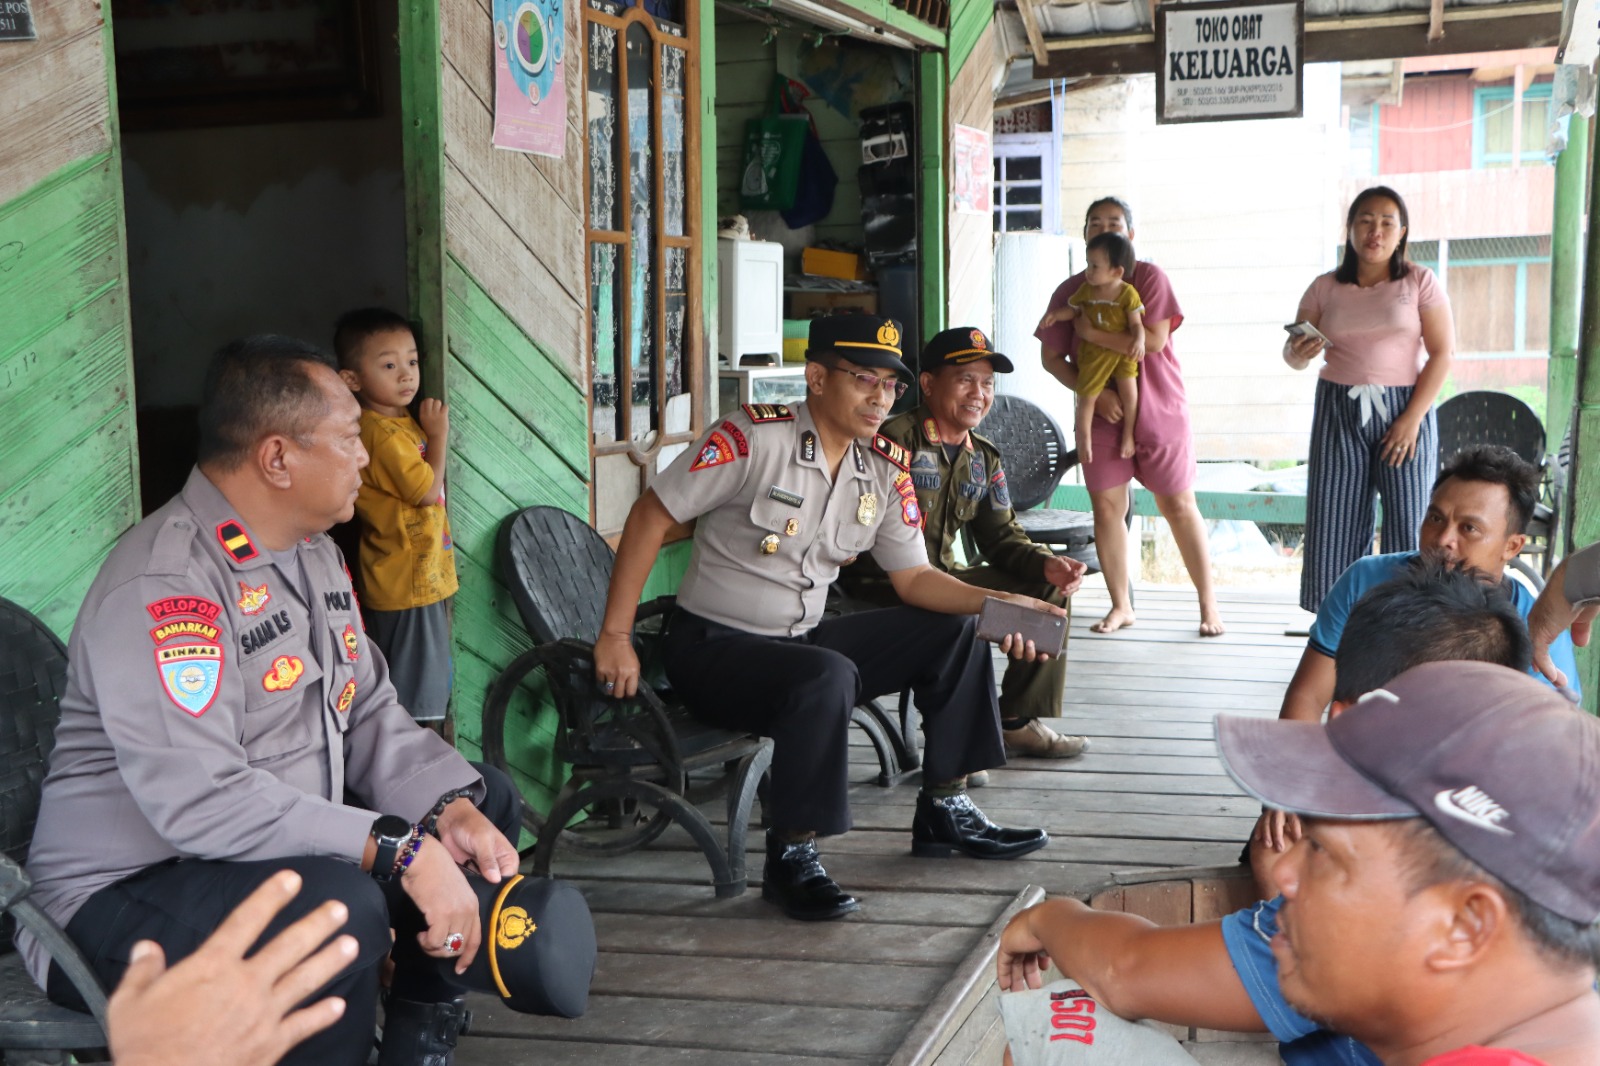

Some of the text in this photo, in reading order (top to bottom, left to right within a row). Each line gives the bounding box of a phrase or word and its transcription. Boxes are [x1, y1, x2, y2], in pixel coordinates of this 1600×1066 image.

[5, 2, 28, 14] POS
[1196, 14, 1263, 43] TOKO OBAT
[1169, 45, 1293, 81] KELUARGA
[153, 599, 216, 618] PELOPOR
[155, 621, 217, 640] BAHARKAM
[163, 647, 217, 659] BINMAS
[1452, 785, 1511, 823] NIKE
